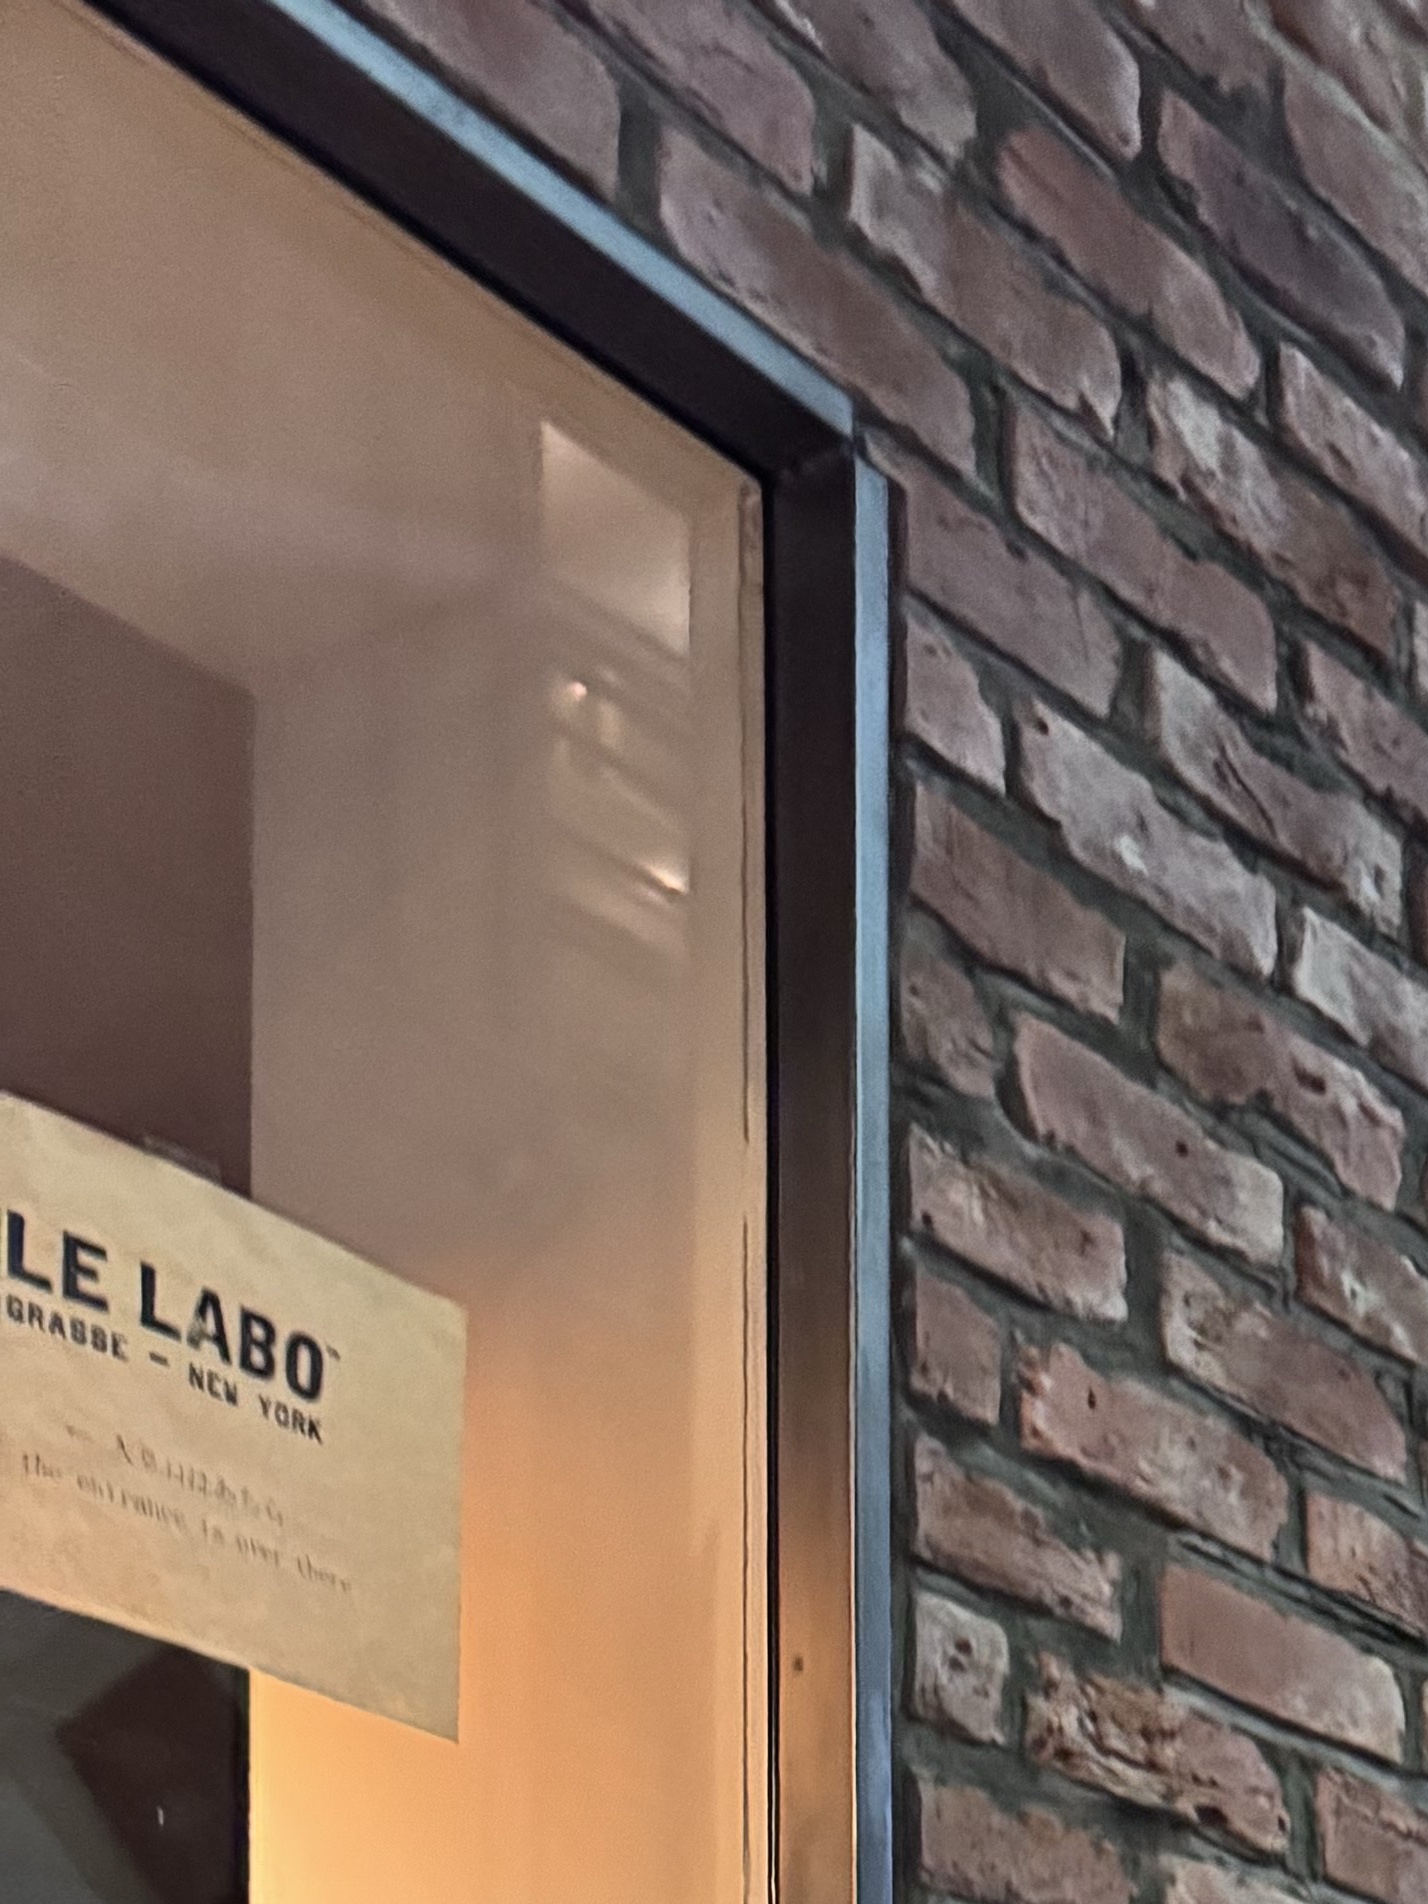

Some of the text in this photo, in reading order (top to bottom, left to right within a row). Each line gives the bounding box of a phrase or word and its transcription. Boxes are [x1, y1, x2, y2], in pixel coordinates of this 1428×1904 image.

[5, 1294, 128, 1362] GRASSE
[187, 1361, 240, 1408] NEW
[257, 1394, 324, 1446] YORK
[6, 1208, 324, 1405] LE LABO
